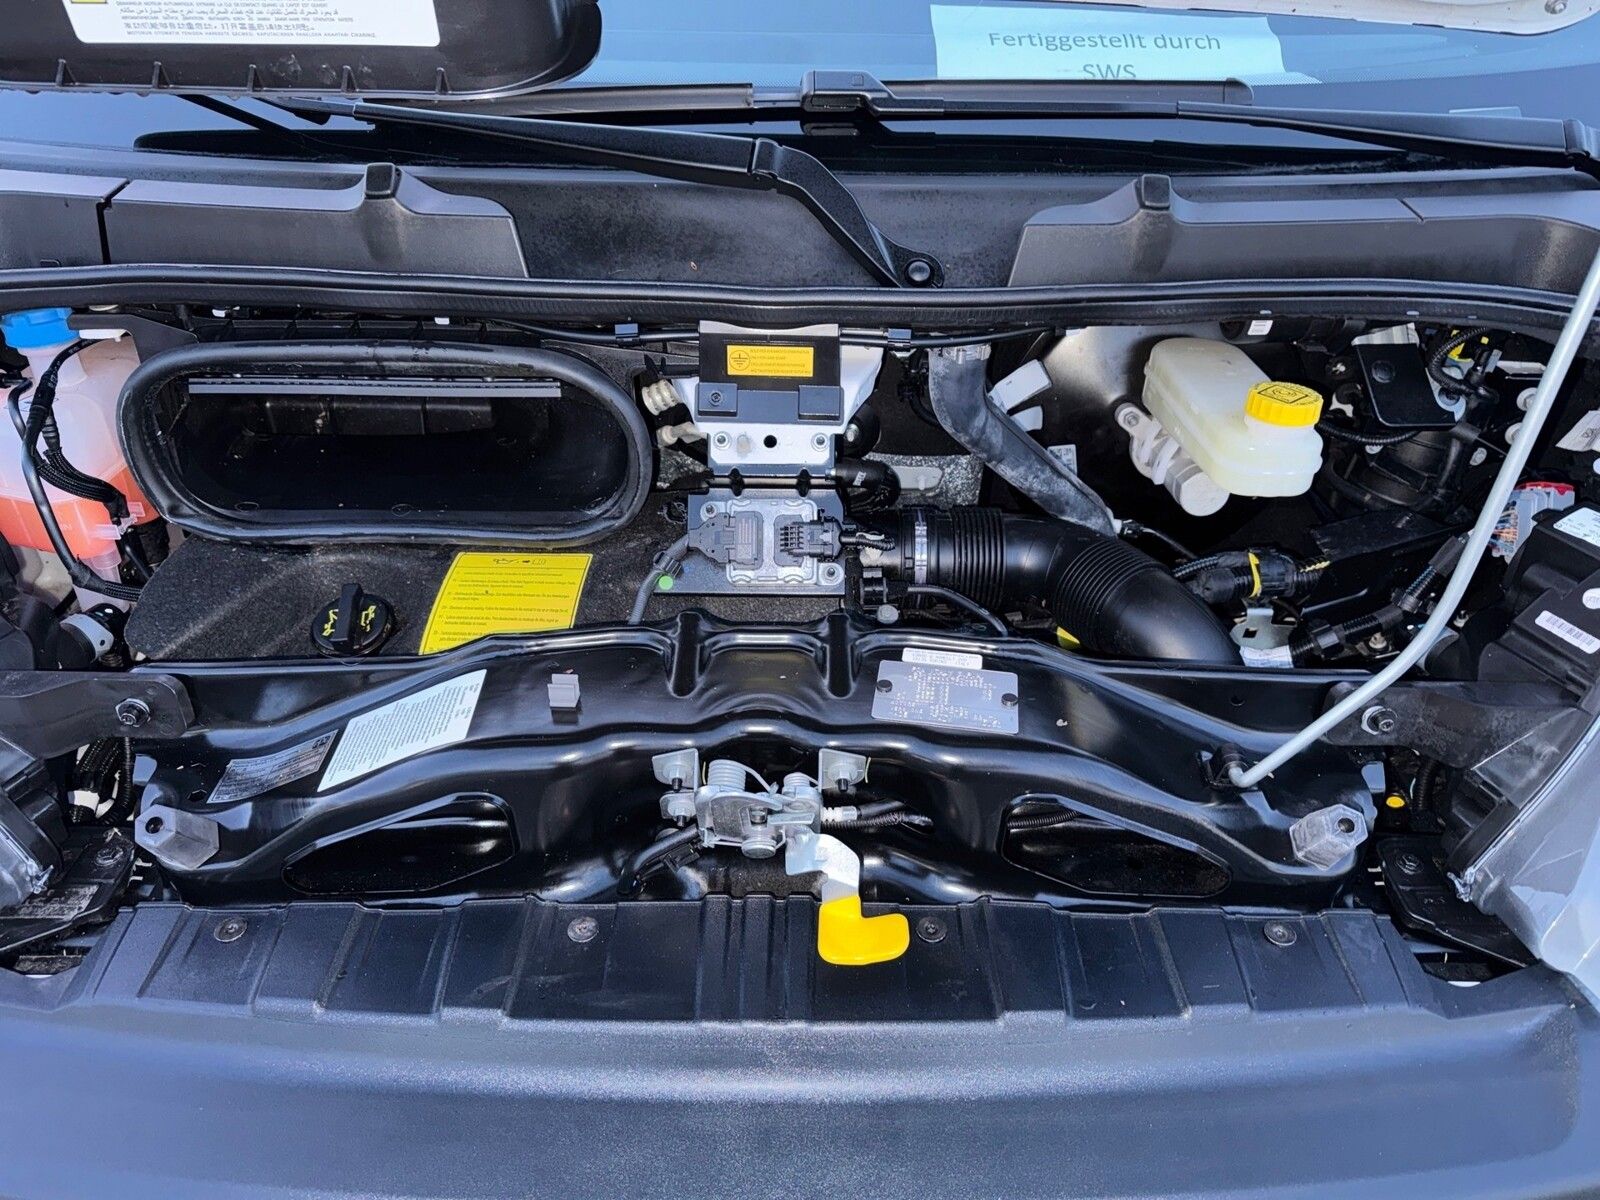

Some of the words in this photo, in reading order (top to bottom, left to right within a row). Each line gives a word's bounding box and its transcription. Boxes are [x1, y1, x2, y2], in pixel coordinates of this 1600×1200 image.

[988, 32, 1147, 51] Fertiggestellt
[1153, 34, 1221, 50] durch
[1082, 63, 1137, 79] SWS
